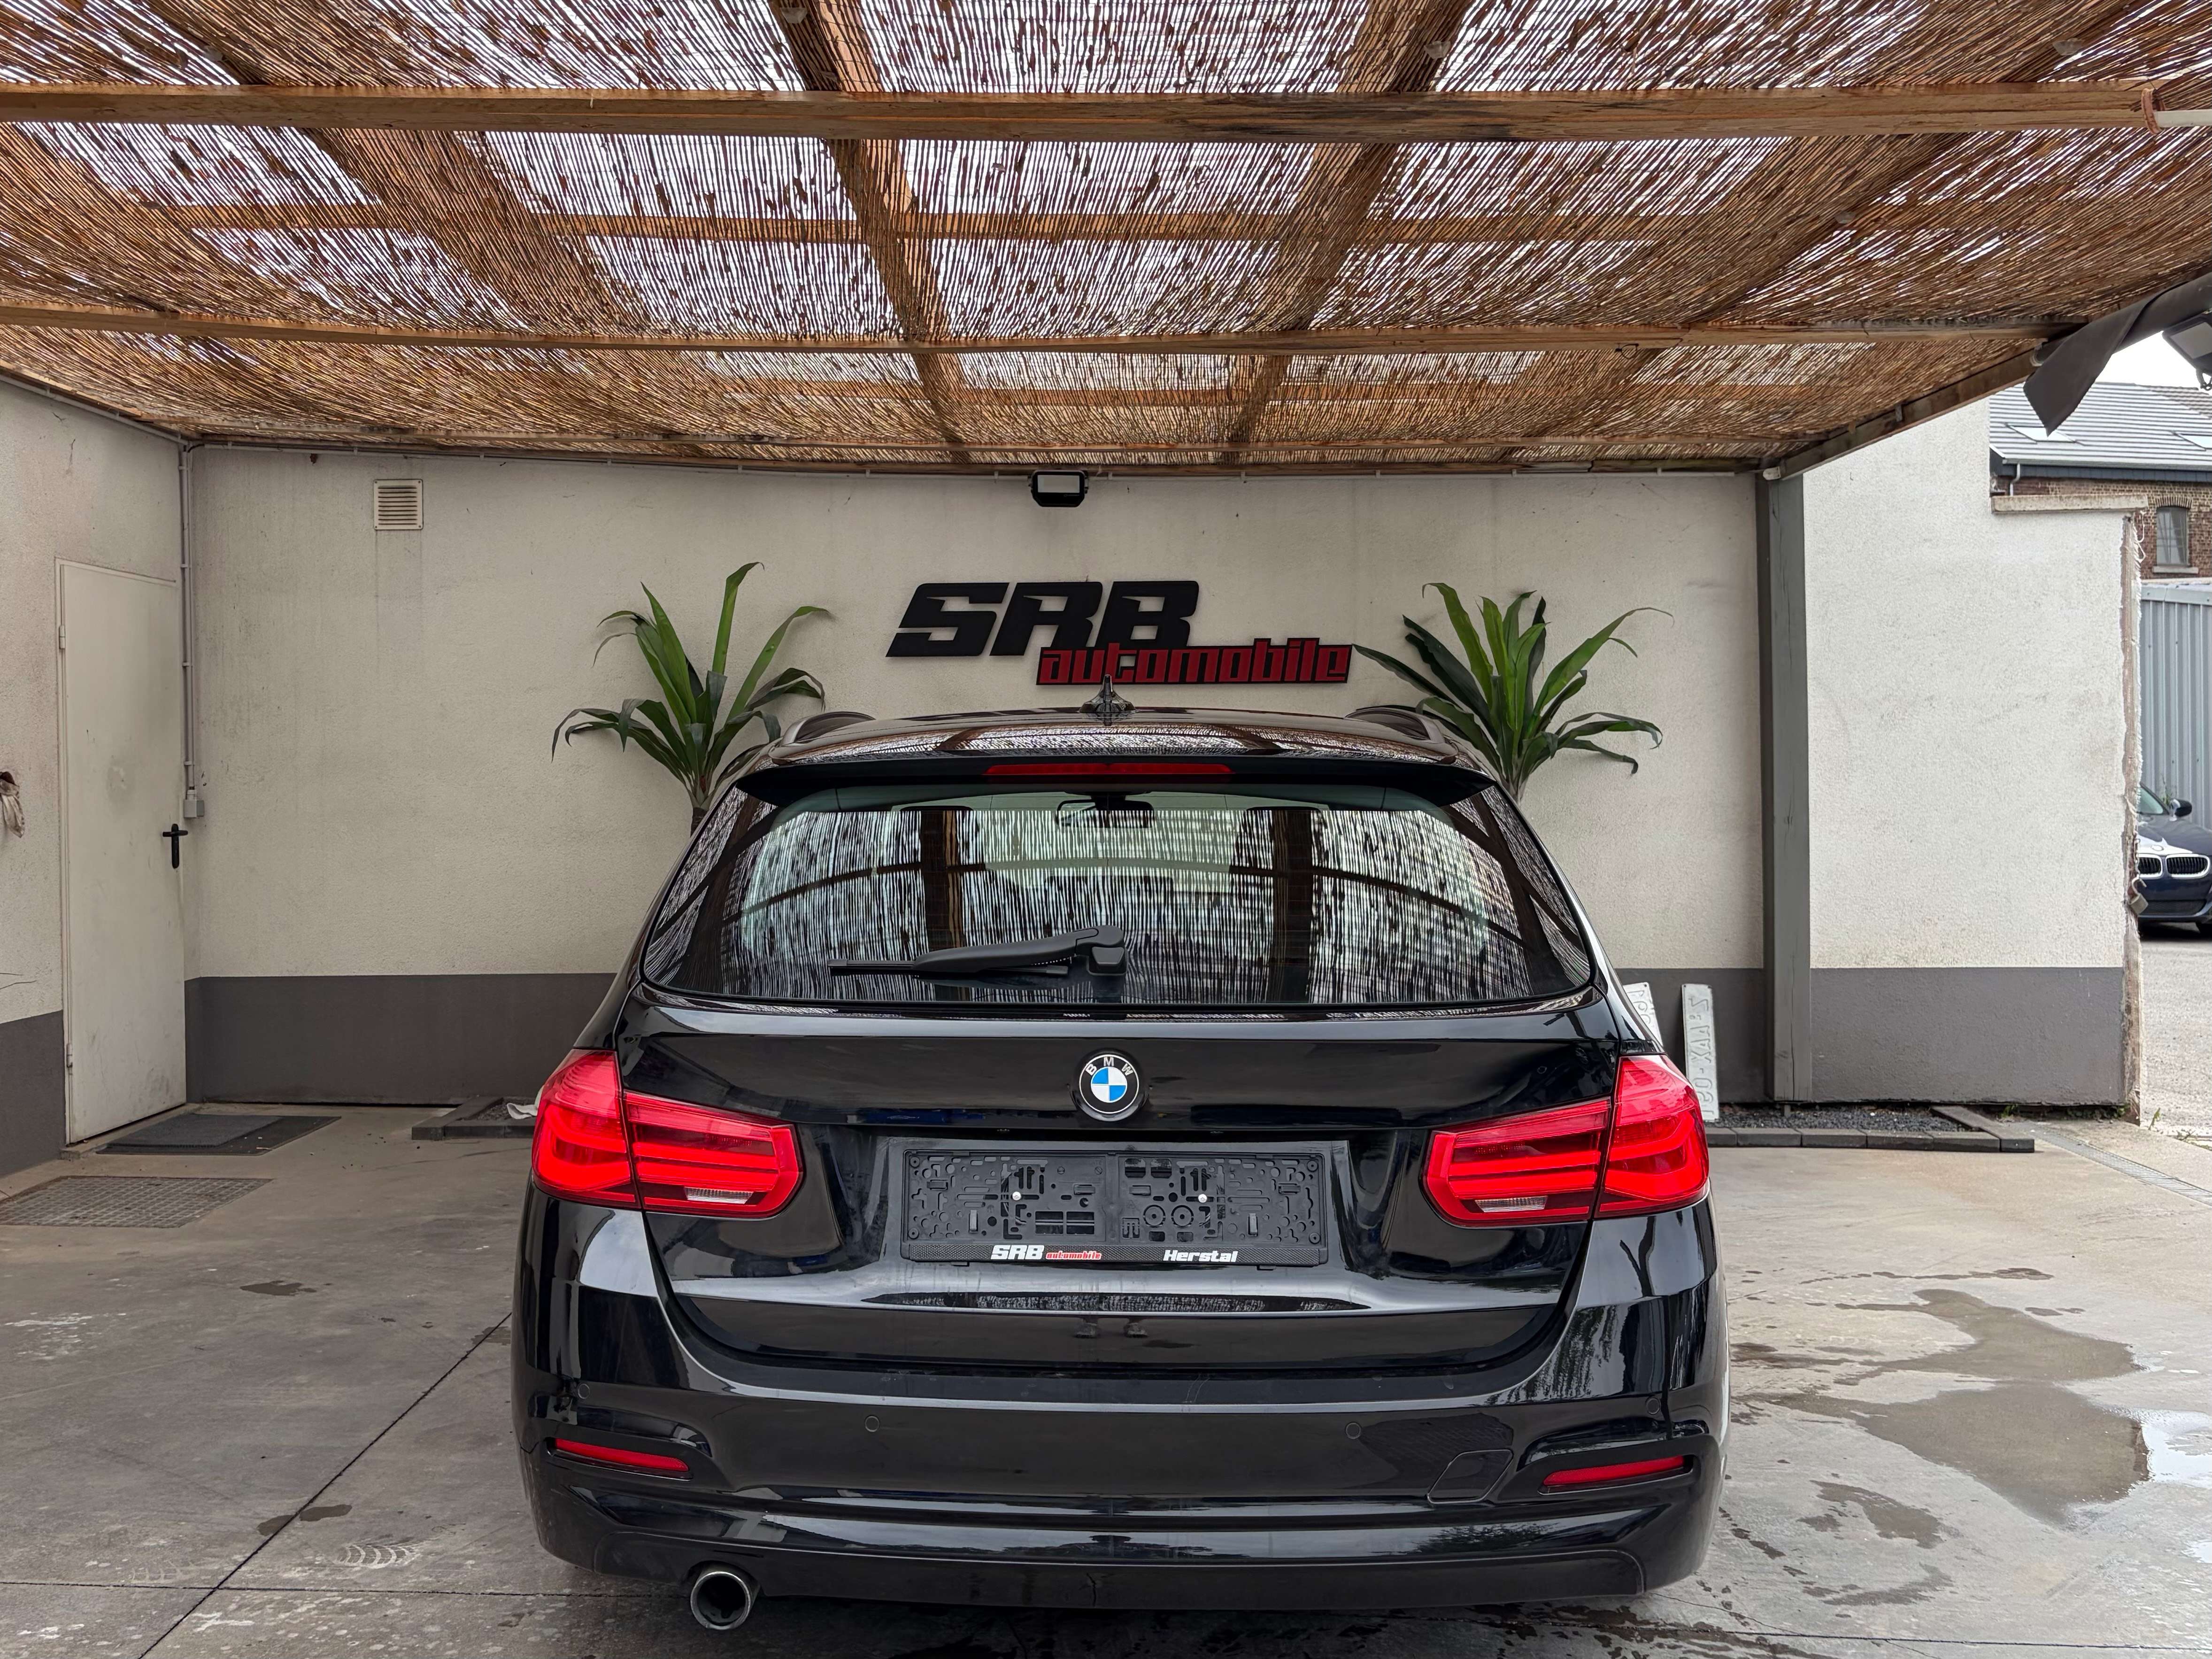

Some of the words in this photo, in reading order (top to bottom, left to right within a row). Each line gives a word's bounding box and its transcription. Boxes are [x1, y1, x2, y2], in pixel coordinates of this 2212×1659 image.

[886, 581, 1199, 657] SRB
[1037, 639, 1352, 684] automobile
[1086, 1057, 1133, 1076] BMW
[990, 1245, 1045, 1260] SRB
[1046, 1250, 1102, 1260] automobile
[1163, 1250, 1239, 1262] Herstal
